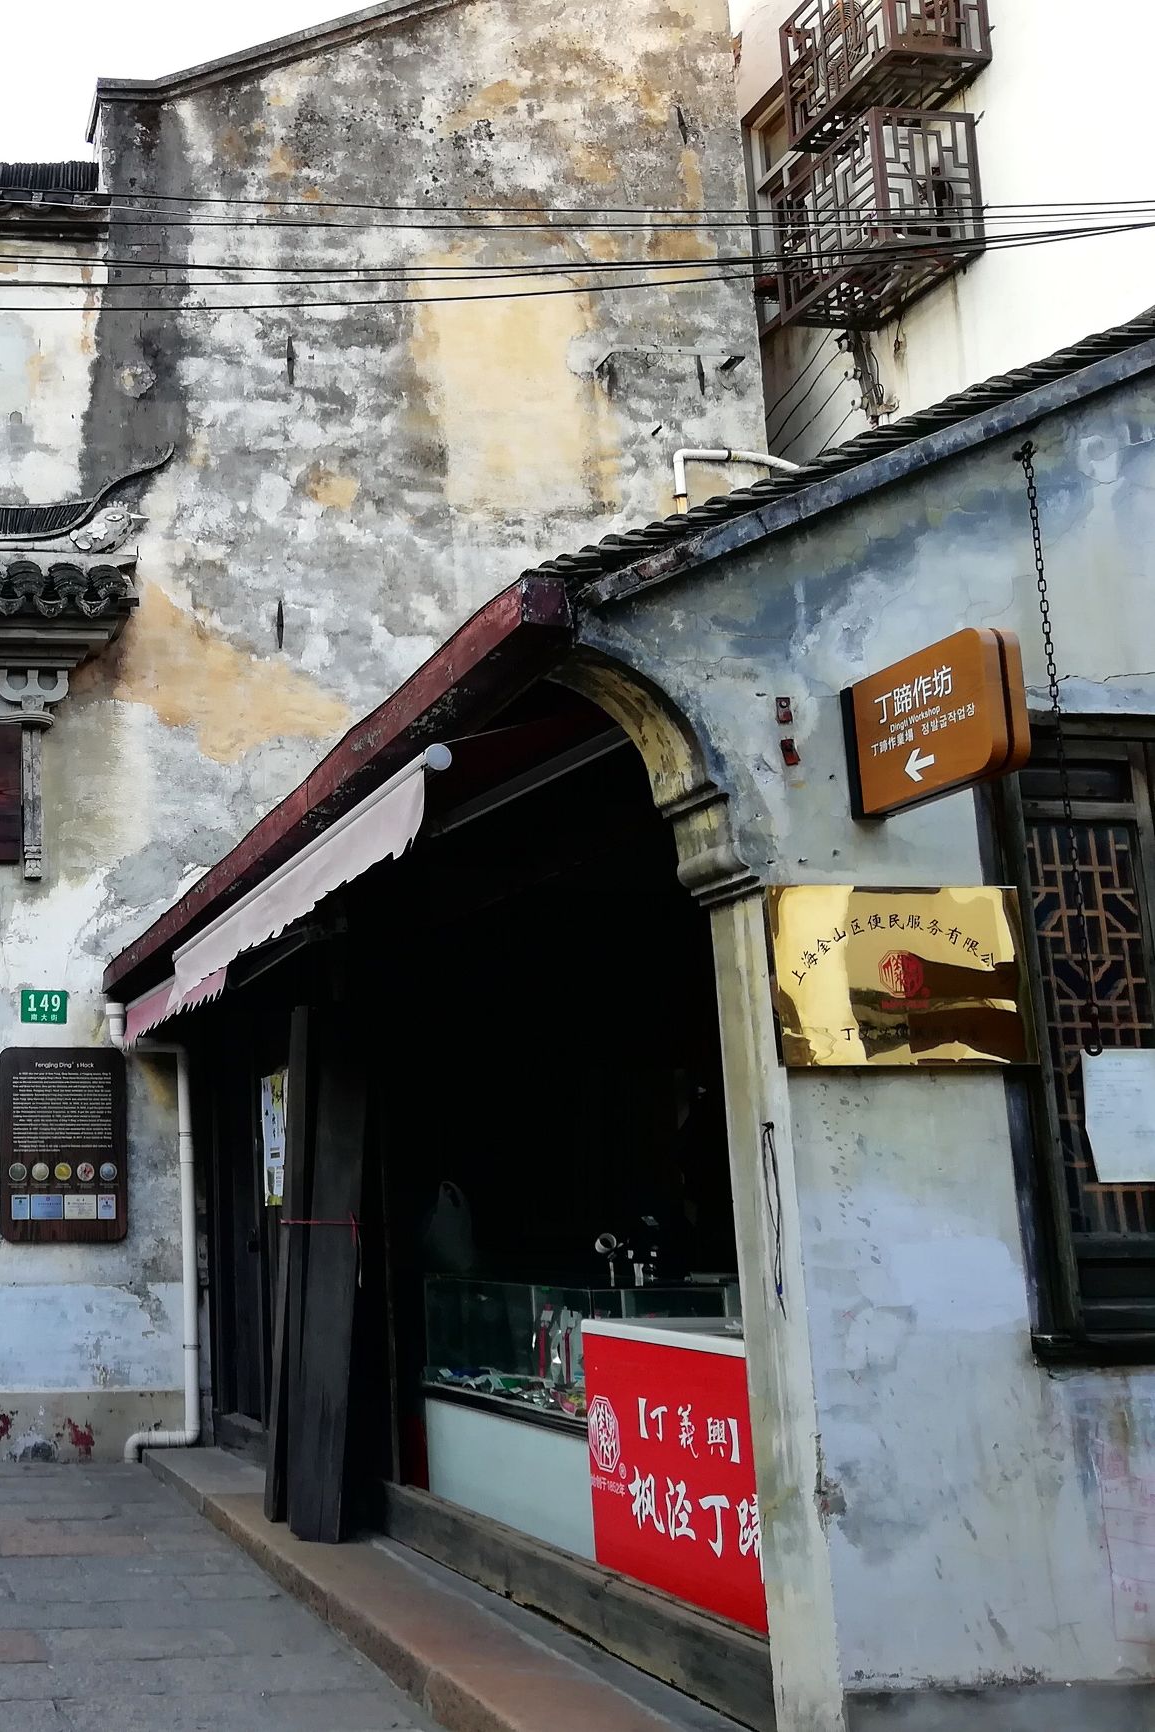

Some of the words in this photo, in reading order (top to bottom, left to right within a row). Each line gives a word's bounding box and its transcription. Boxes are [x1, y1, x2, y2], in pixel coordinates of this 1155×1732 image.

[874, 665, 953, 724] 丁蹄作坊
[909, 706, 941, 724] Workshop
[791, 913, 997, 986] 上海金山区便民服务有限公
[28, 994, 61, 1012] 149
